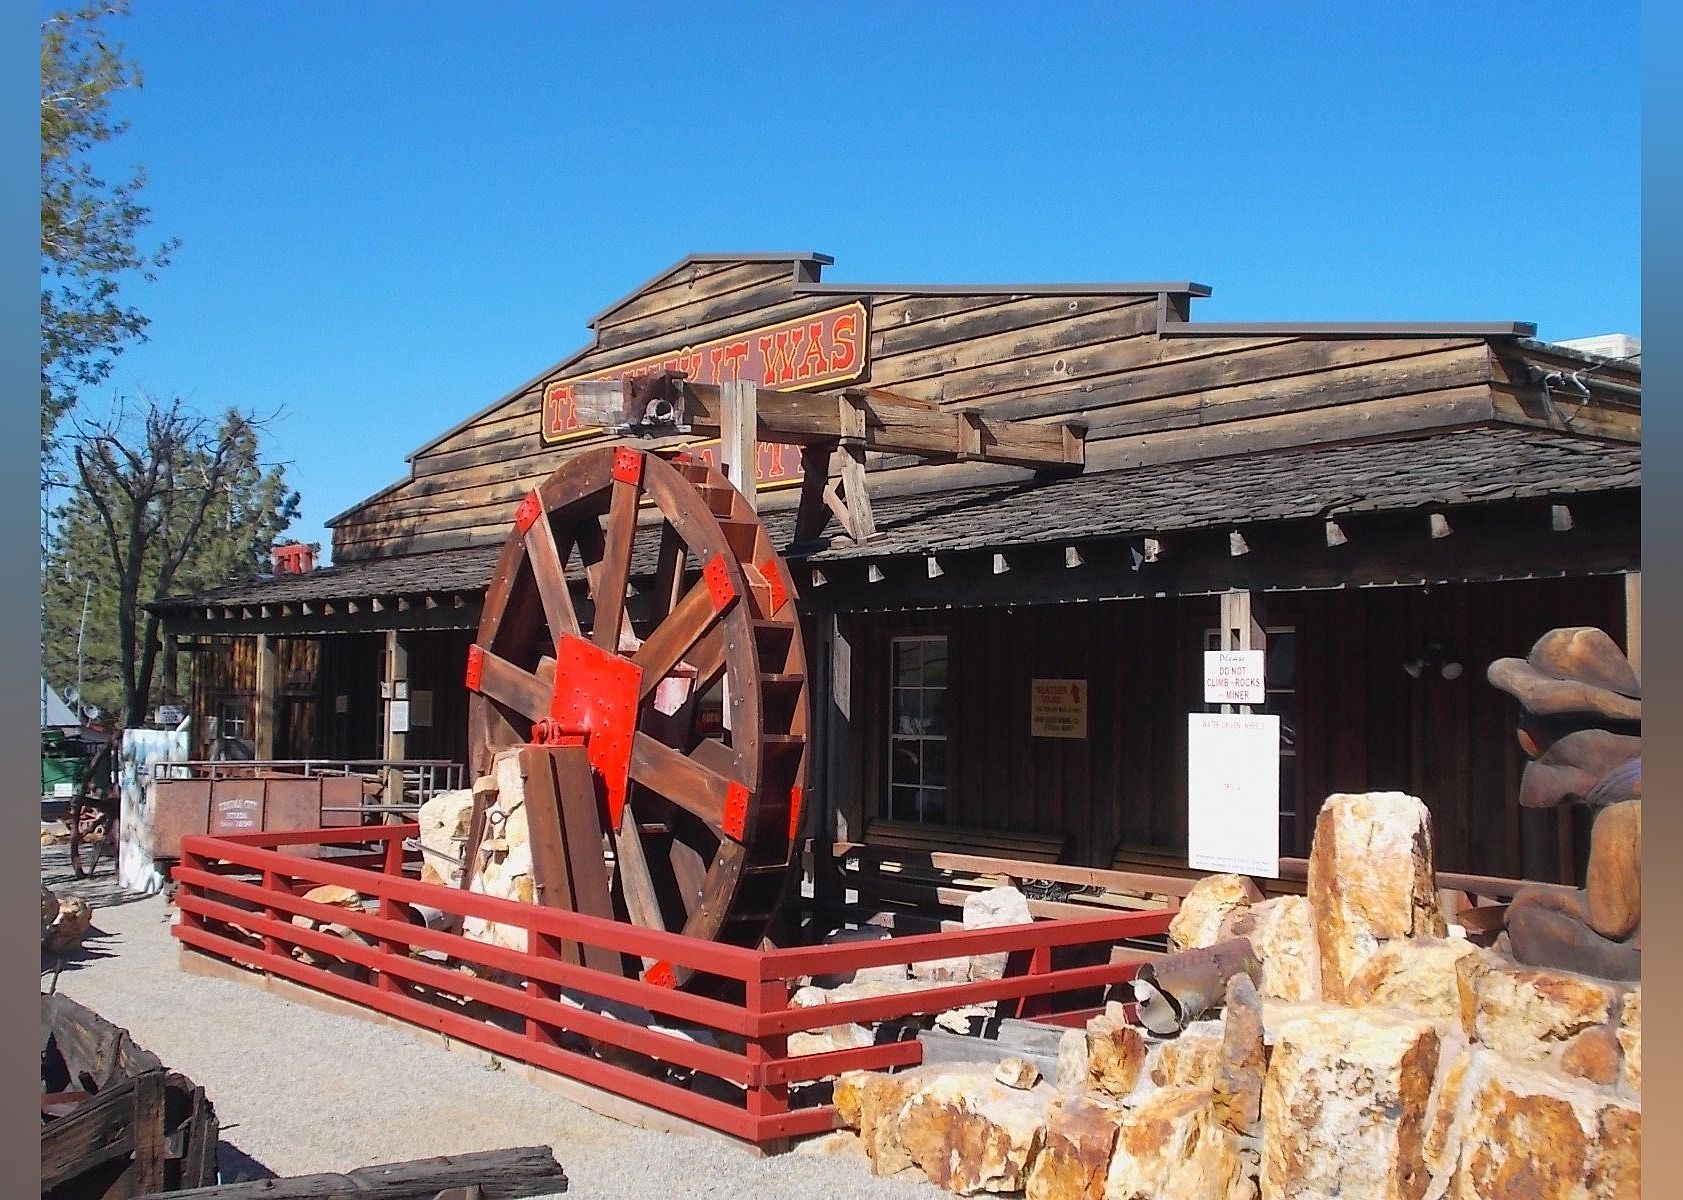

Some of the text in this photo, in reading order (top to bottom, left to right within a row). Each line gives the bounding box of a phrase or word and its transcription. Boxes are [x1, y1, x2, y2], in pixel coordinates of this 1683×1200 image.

[710, 340, 750, 385] IT
[758, 313, 858, 387] WAS
[1219, 666, 1247, 676] DO NOT
[1206, 678, 1229, 687] CLIMB
[1235, 678, 1261, 687] ROCKS
[1226, 690, 1250, 700] MINER
